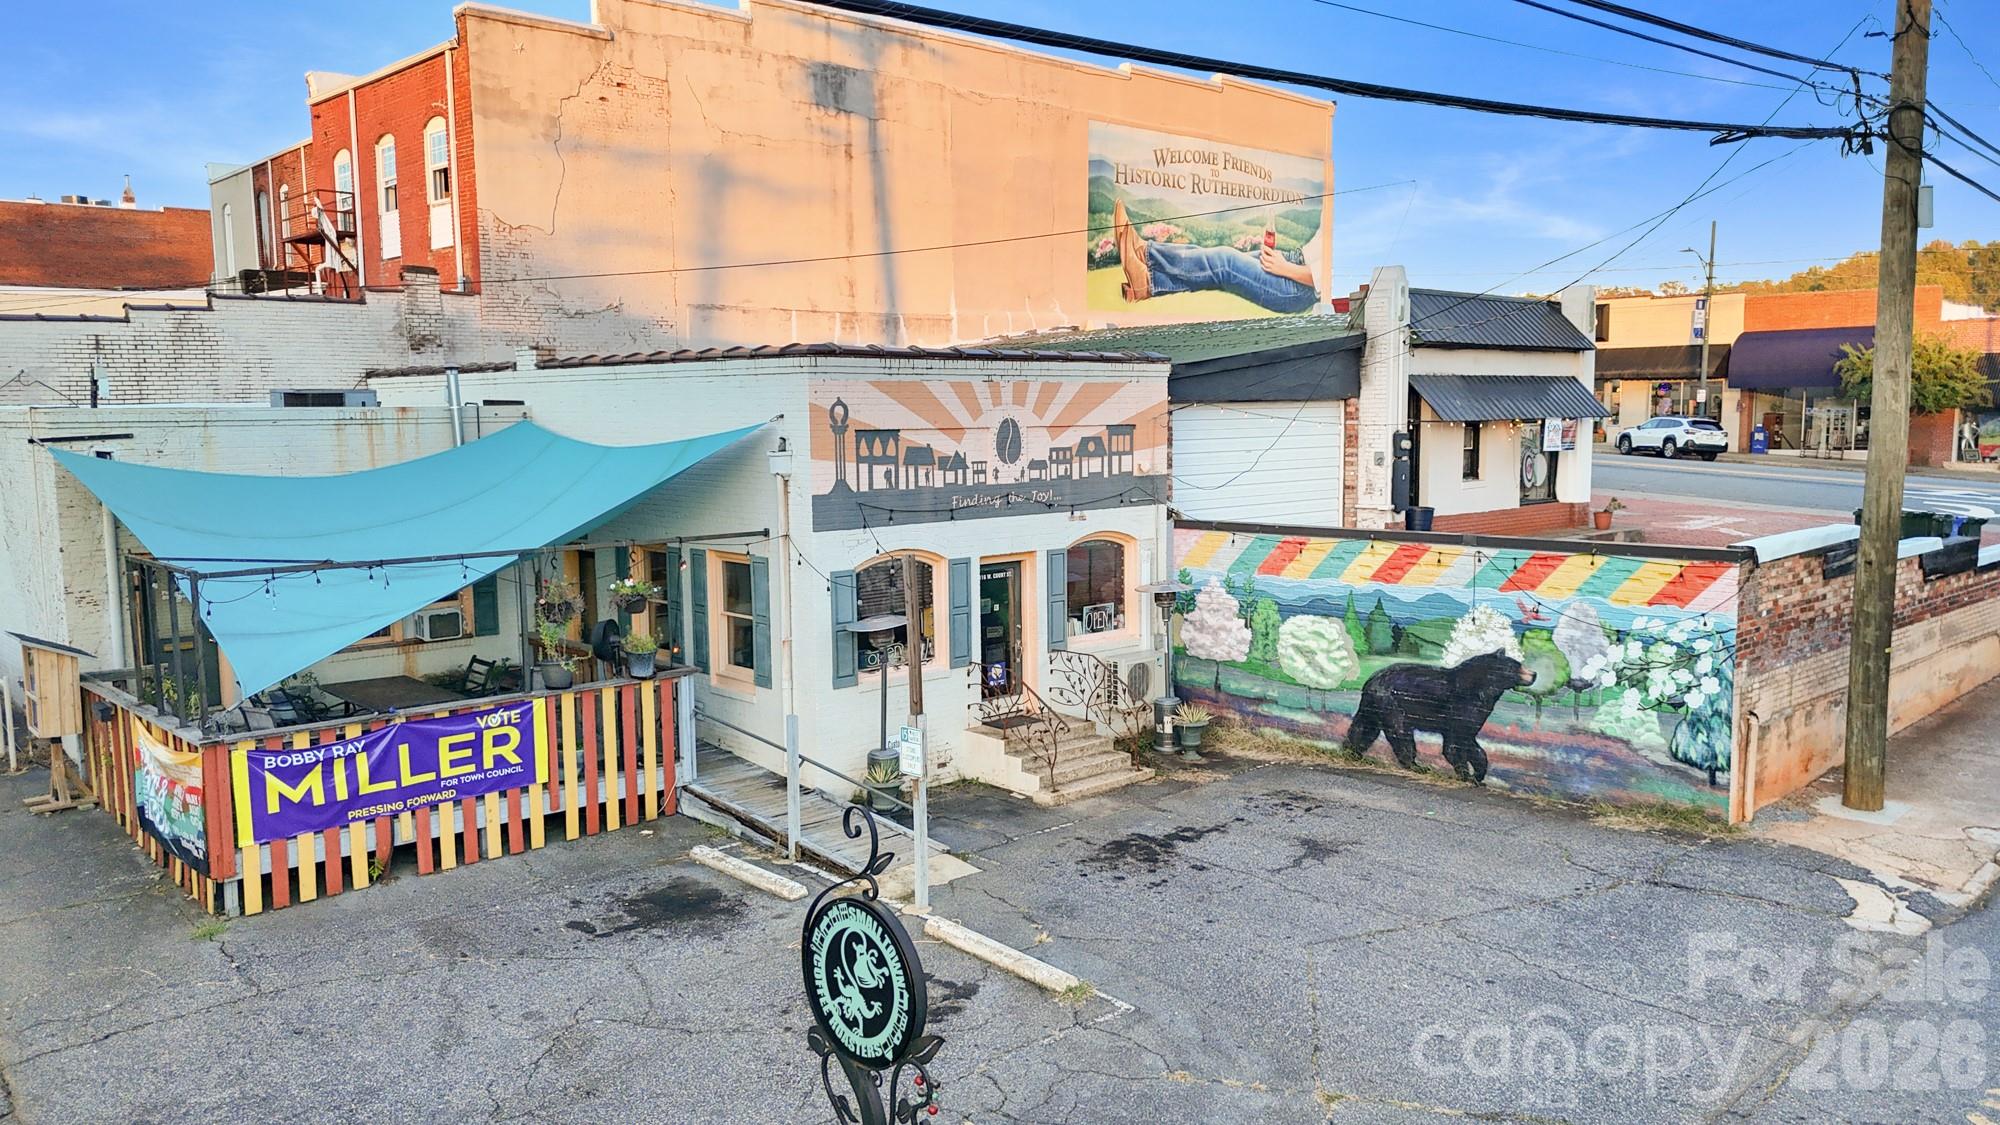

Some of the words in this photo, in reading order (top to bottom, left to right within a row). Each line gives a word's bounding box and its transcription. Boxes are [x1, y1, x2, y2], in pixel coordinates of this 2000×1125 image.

[1154, 148, 1219, 168] WELCOME
[1223, 151, 1272, 183] FRIENDS
[1211, 168, 1219, 178] TO
[1114, 162, 1186, 189] HISTORIC
[1191, 173, 1305, 205] RUTHERFORDTON
[951, 493, 1001, 508] Finding
[1008, 491, 1025, 503] the
[1086, 610, 1109, 630] OPEN
[476, 709, 521, 728] VOTE
[264, 748, 325, 769] BOBBY
[332, 740, 366, 758] RAY
[264, 725, 523, 814] MILLER
[440, 778, 459, 788] FOR
[460, 773, 485, 784] TOWN
[486, 765, 524, 779] COUNCIL
[348, 801, 404, 820] PRESSING
[406, 788, 457, 808] FORWARD
[848, 906, 885, 942] SMALL
[882, 934, 906, 989] TOWN
[828, 1016, 883, 1059] ROASTERS
